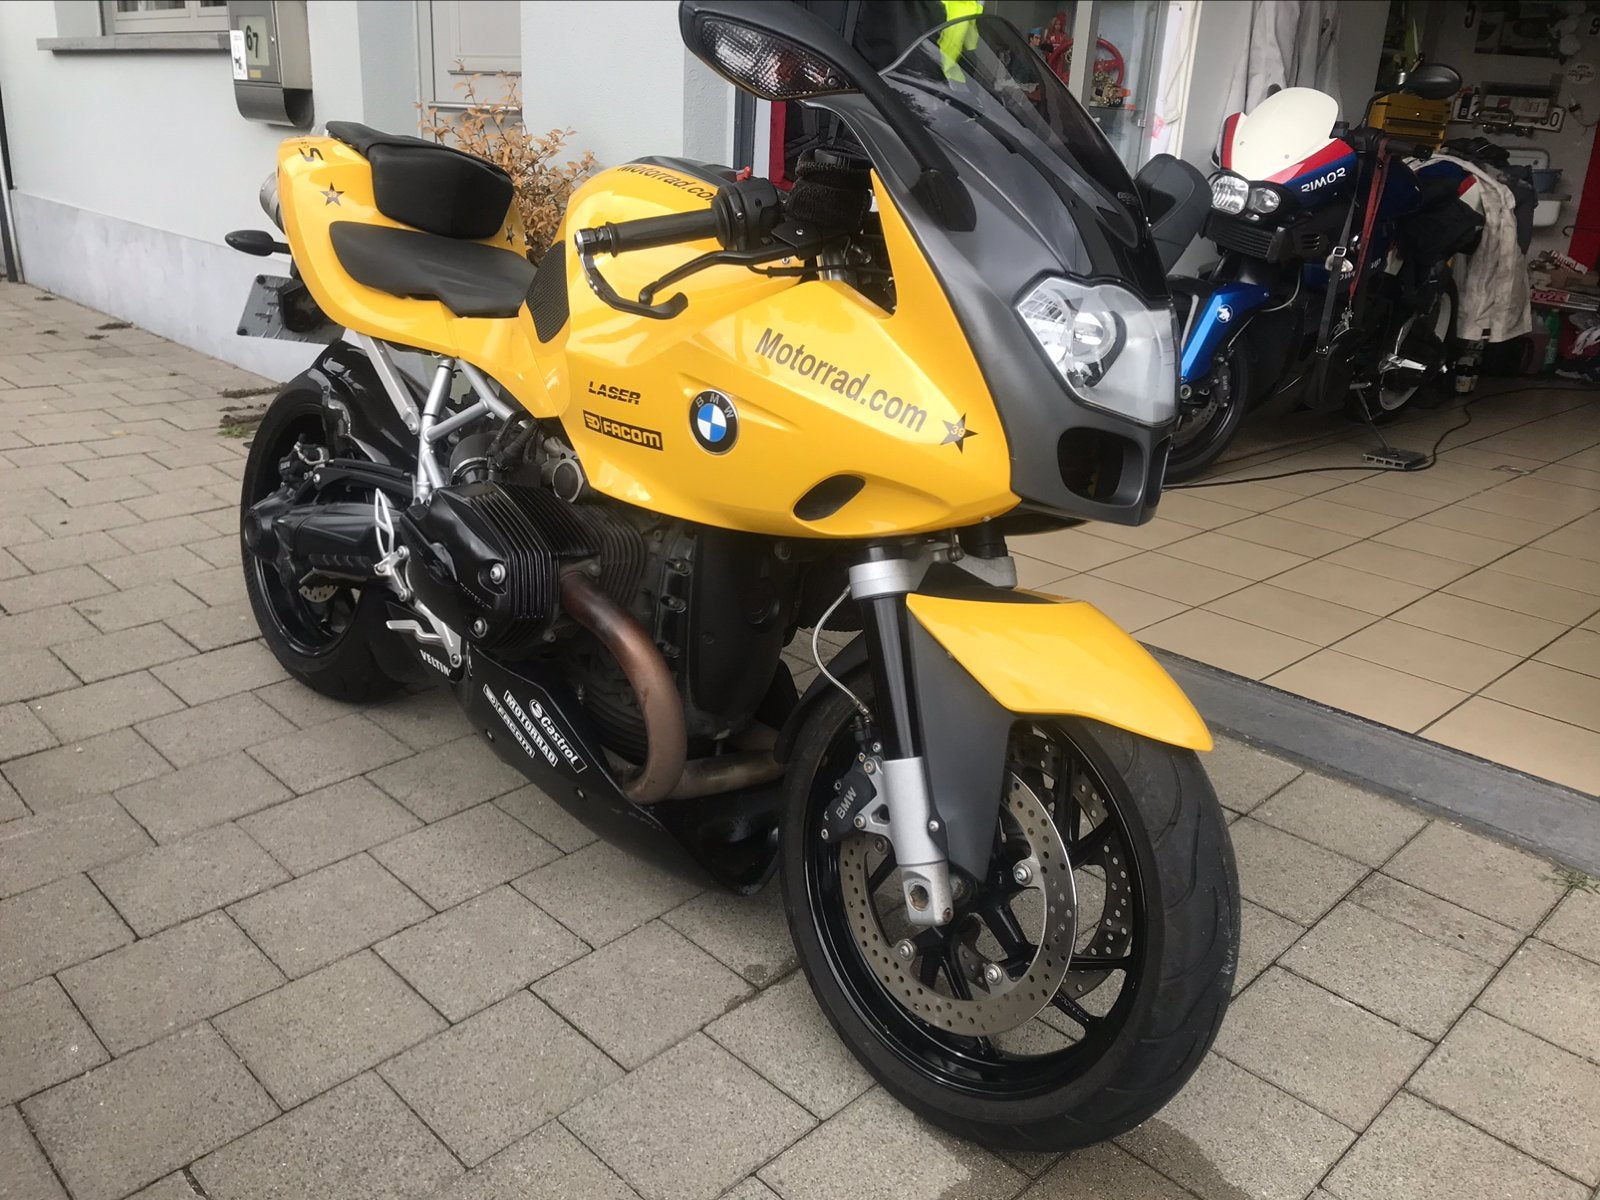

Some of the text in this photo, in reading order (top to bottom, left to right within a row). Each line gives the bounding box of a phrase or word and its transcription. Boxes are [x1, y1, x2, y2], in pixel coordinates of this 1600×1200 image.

[245, 24, 259, 58] 67
[588, 381, 641, 405] LASER
[754, 327, 928, 433] Motorrad.com
[695, 392, 735, 419] BMW
[951, 425, 966, 437] 39
[506, 694, 557, 766] MOTORRAD
[541, 716, 579, 765] Castrol
[836, 786, 857, 819] BMW
